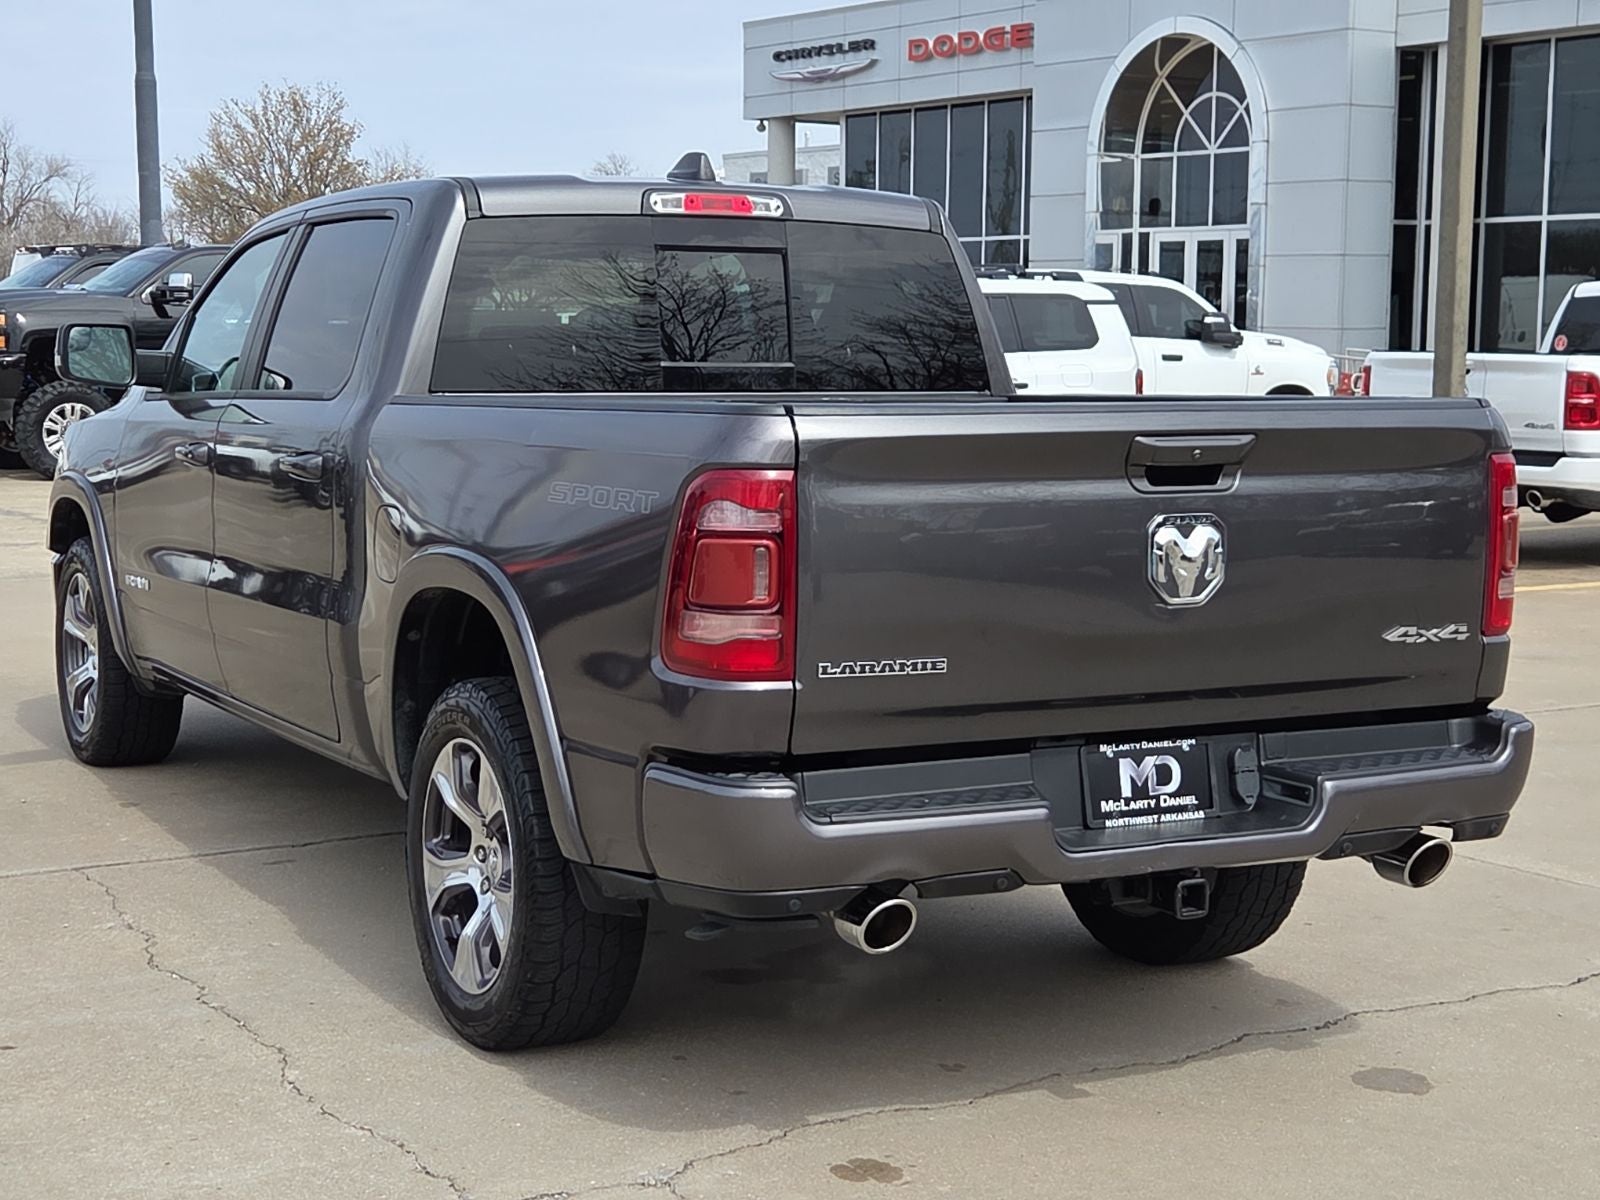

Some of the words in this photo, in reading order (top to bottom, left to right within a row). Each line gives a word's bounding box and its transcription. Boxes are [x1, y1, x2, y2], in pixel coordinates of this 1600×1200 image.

[772, 38, 876, 63] CHRYSLER
[907, 22, 1034, 62] DODGE
[547, 481, 660, 514] SPORT
[818, 658, 947, 678] LARAMIE
[1105, 814, 1159, 827] NORTHWEST
[1160, 810, 1205, 822] ARKANSAS
